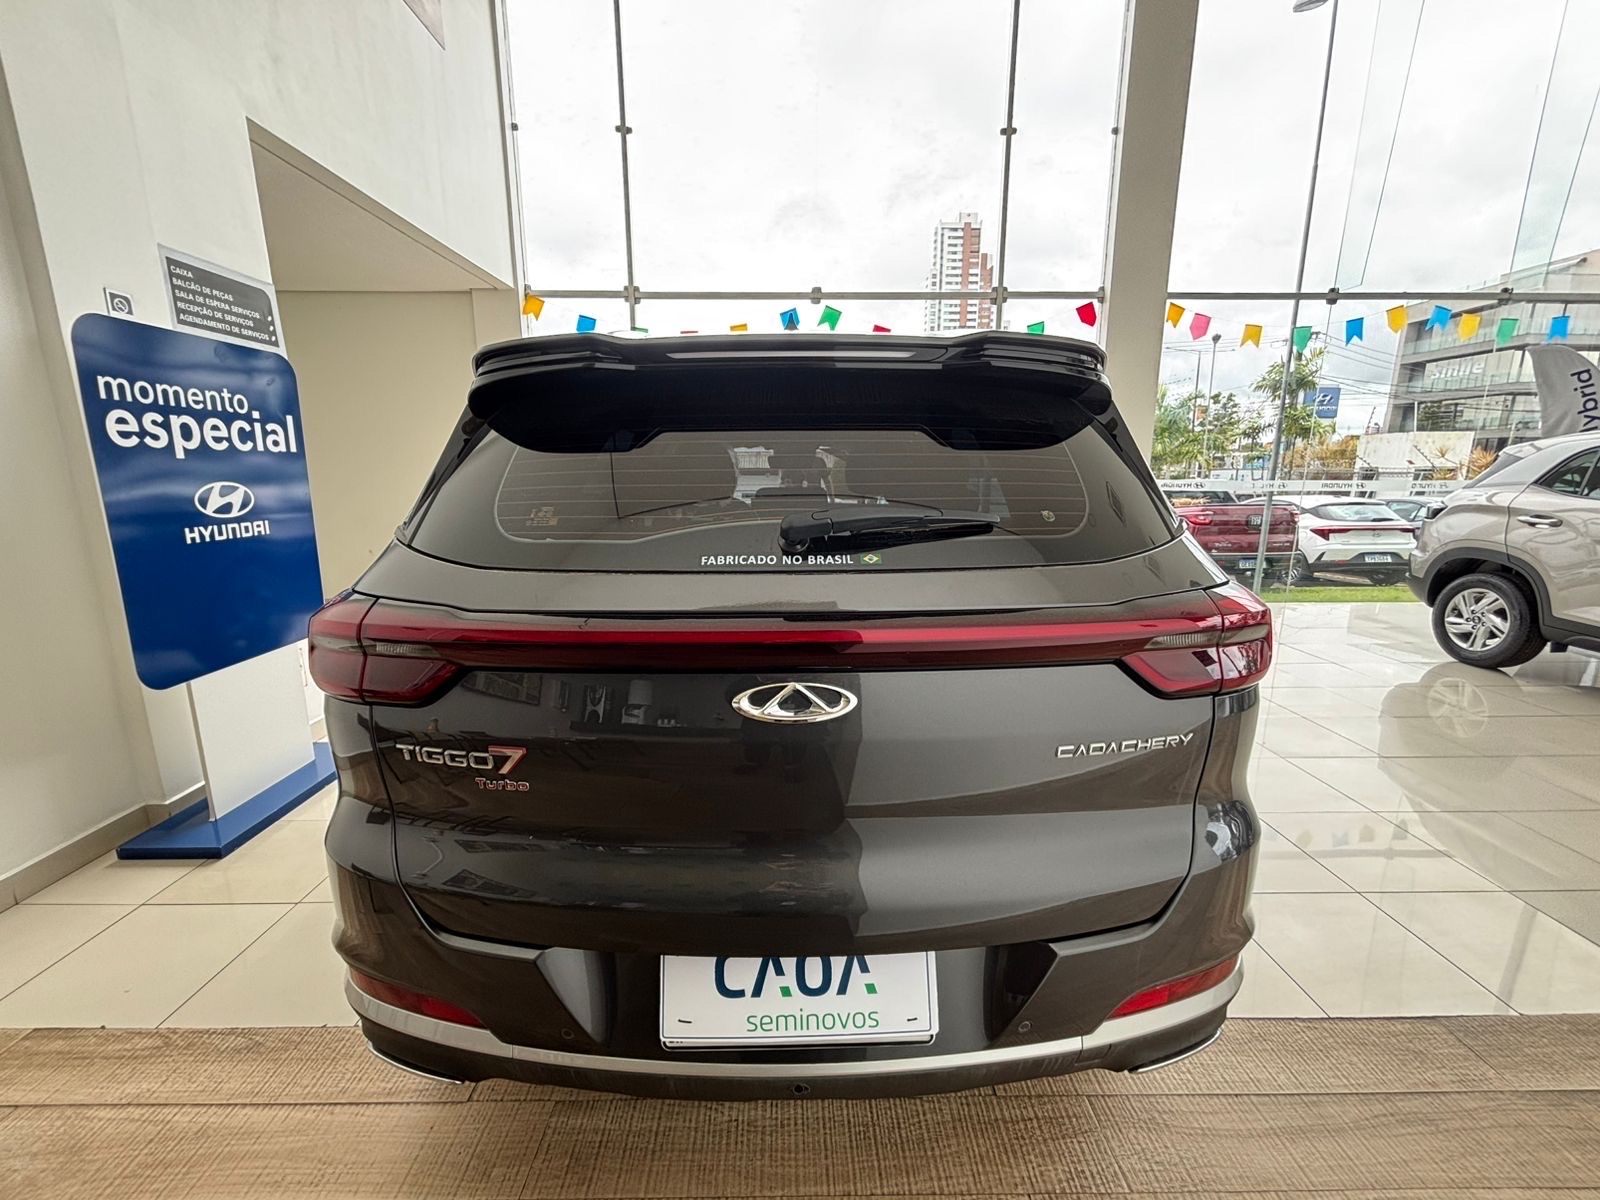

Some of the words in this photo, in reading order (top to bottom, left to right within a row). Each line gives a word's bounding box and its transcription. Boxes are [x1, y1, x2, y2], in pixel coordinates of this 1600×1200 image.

[170, 265, 194, 278] CAIXA
[172, 277, 201, 291] BALCÃO
[202, 286, 211, 295] DE
[212, 289, 234, 301] PEÇAS
[174, 289, 194, 301] SALA
[195, 295, 205, 304] DE
[205, 298, 230, 310] ESPERA
[231, 305, 260, 319] SERVIÇOS
[177, 301, 213, 316] RECEPÇÃO
[214, 311, 223, 319] DE
[224, 313, 254, 327] SERVIÇOS
[179, 313, 231, 332] AGENDAMENTO
[232, 325, 240, 334] DE
[241, 328, 270, 340] SERVIÇOS
[96, 375, 249, 414] momento
[105, 408, 298, 460] especial
[184, 519, 270, 544] HYUNDAI
[701, 555, 777, 566] FABRICADO
[782, 555, 803, 565] NO
[807, 554, 854, 565] BRASIL
[474, 777, 530, 791] Turbo
[746, 1008, 880, 1033] seminovos
